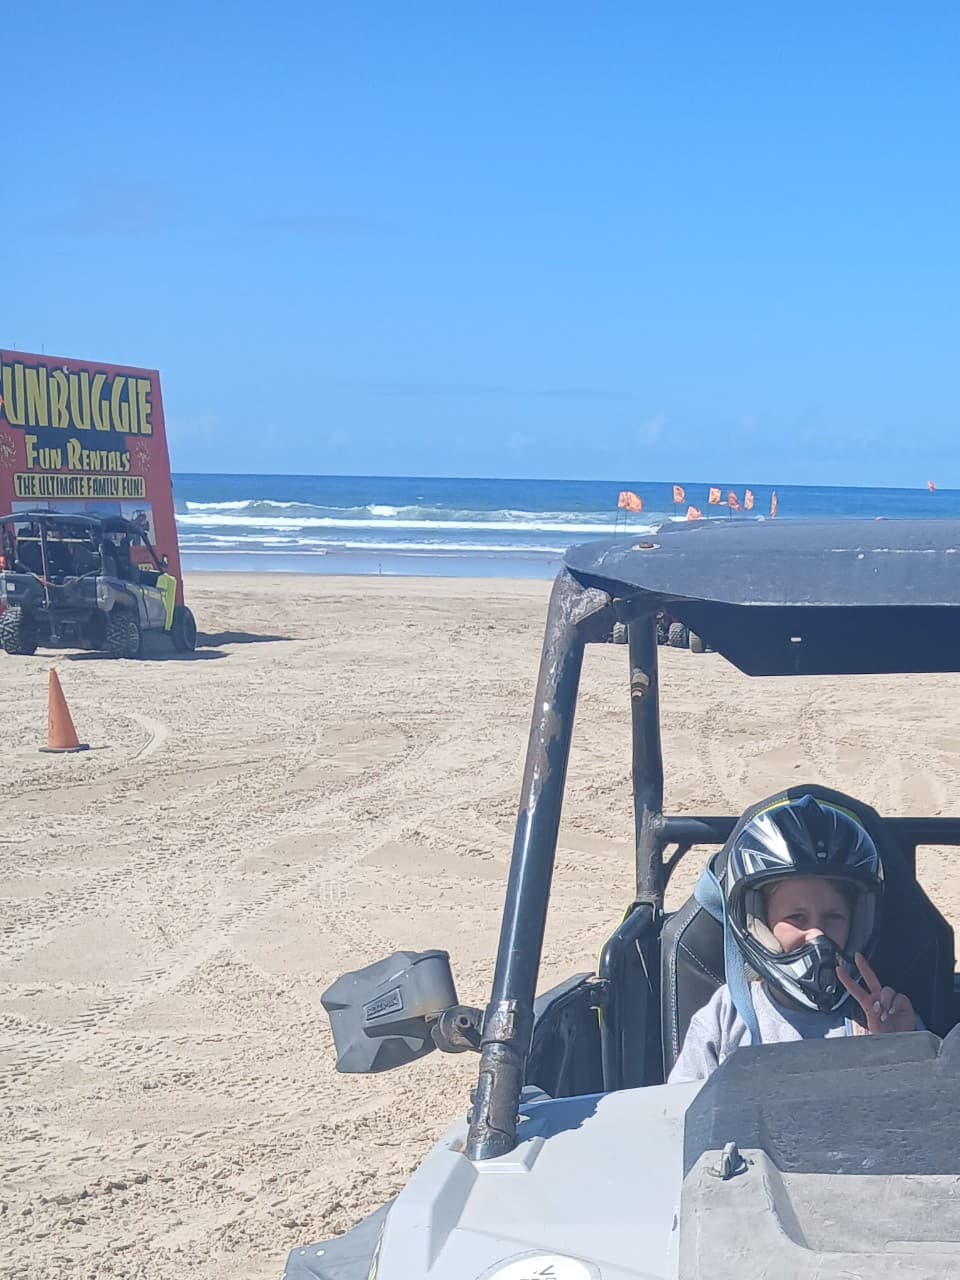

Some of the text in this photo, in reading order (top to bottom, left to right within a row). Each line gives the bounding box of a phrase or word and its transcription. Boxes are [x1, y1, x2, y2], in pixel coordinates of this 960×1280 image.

[0, 363, 152, 435] UNBUGGIE
[16, 474, 144, 497] THE ULTIMATE FAMILY FUN!
